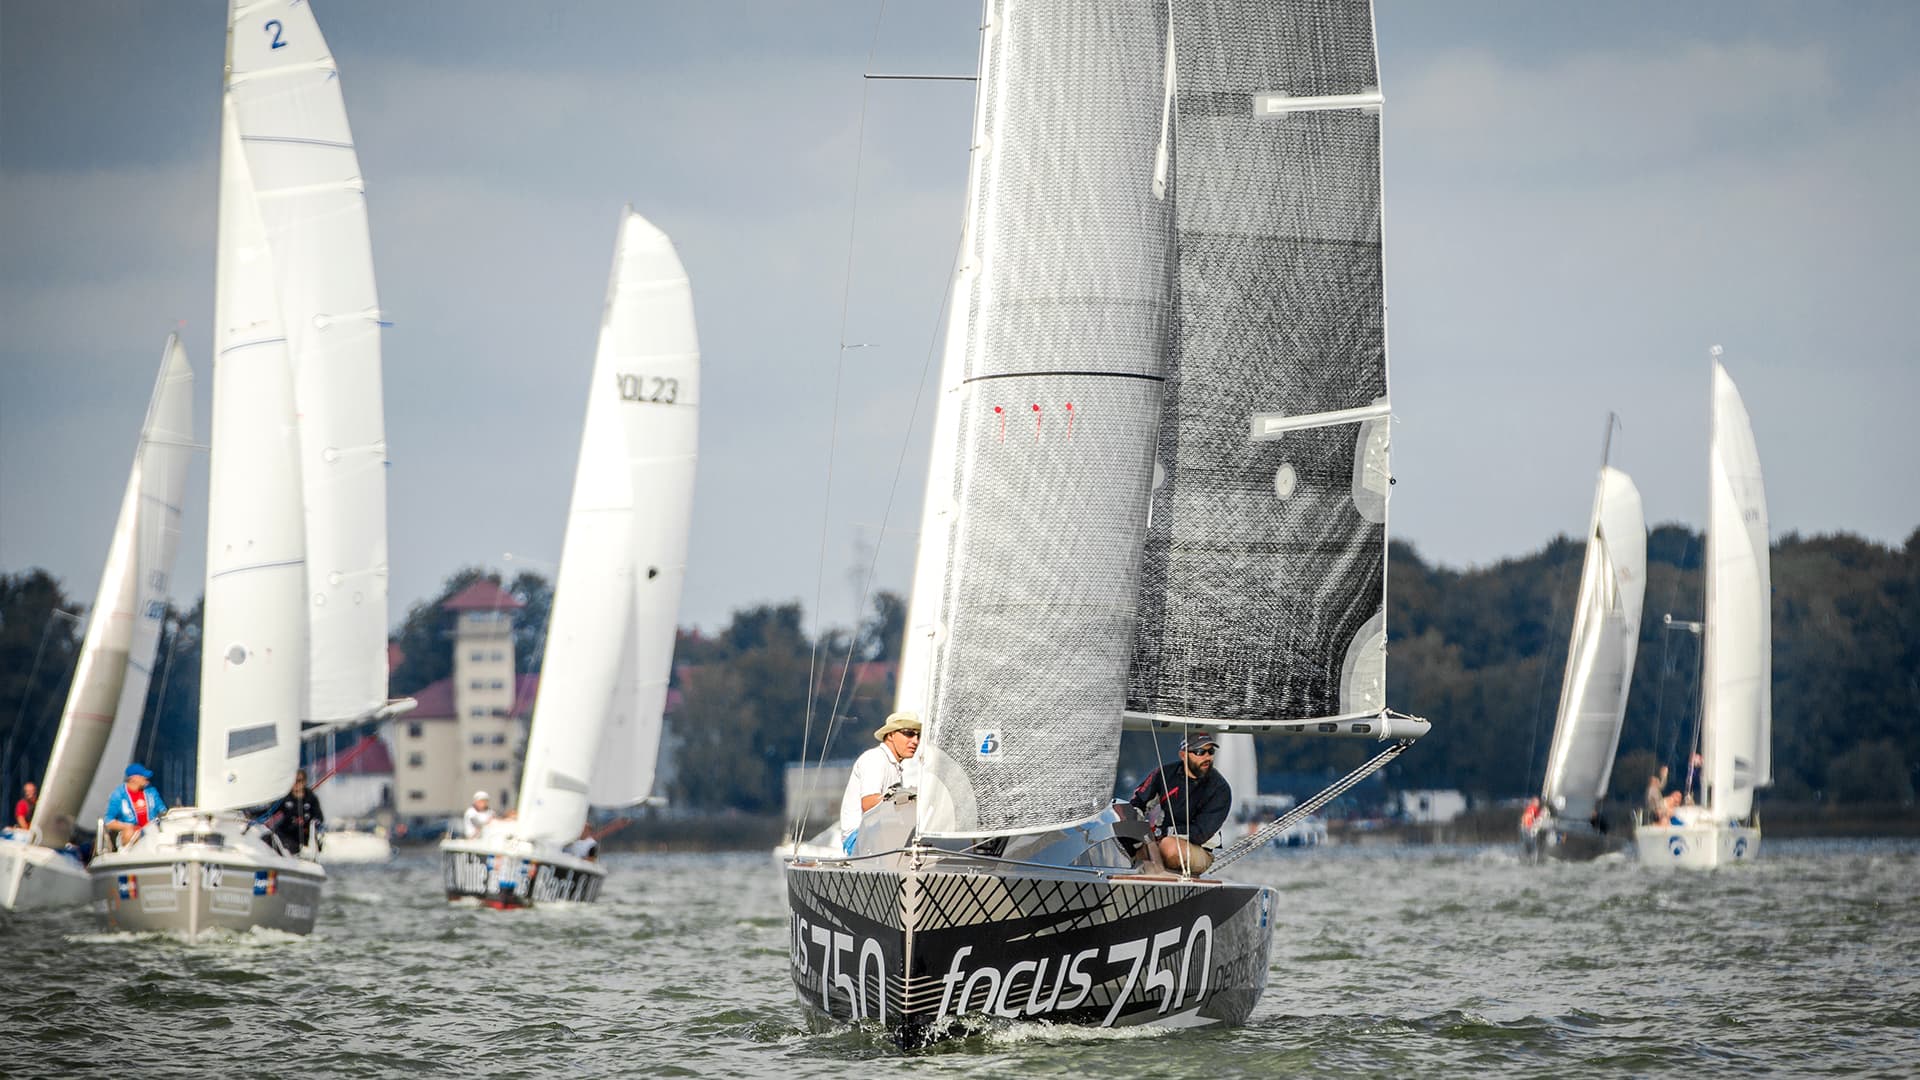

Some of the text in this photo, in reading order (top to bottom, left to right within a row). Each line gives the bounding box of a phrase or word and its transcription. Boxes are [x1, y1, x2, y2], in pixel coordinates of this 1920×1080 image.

[264, 19, 287, 49] 2
[811, 924, 886, 1025] 750
[936, 914, 1213, 1028] focus 750
